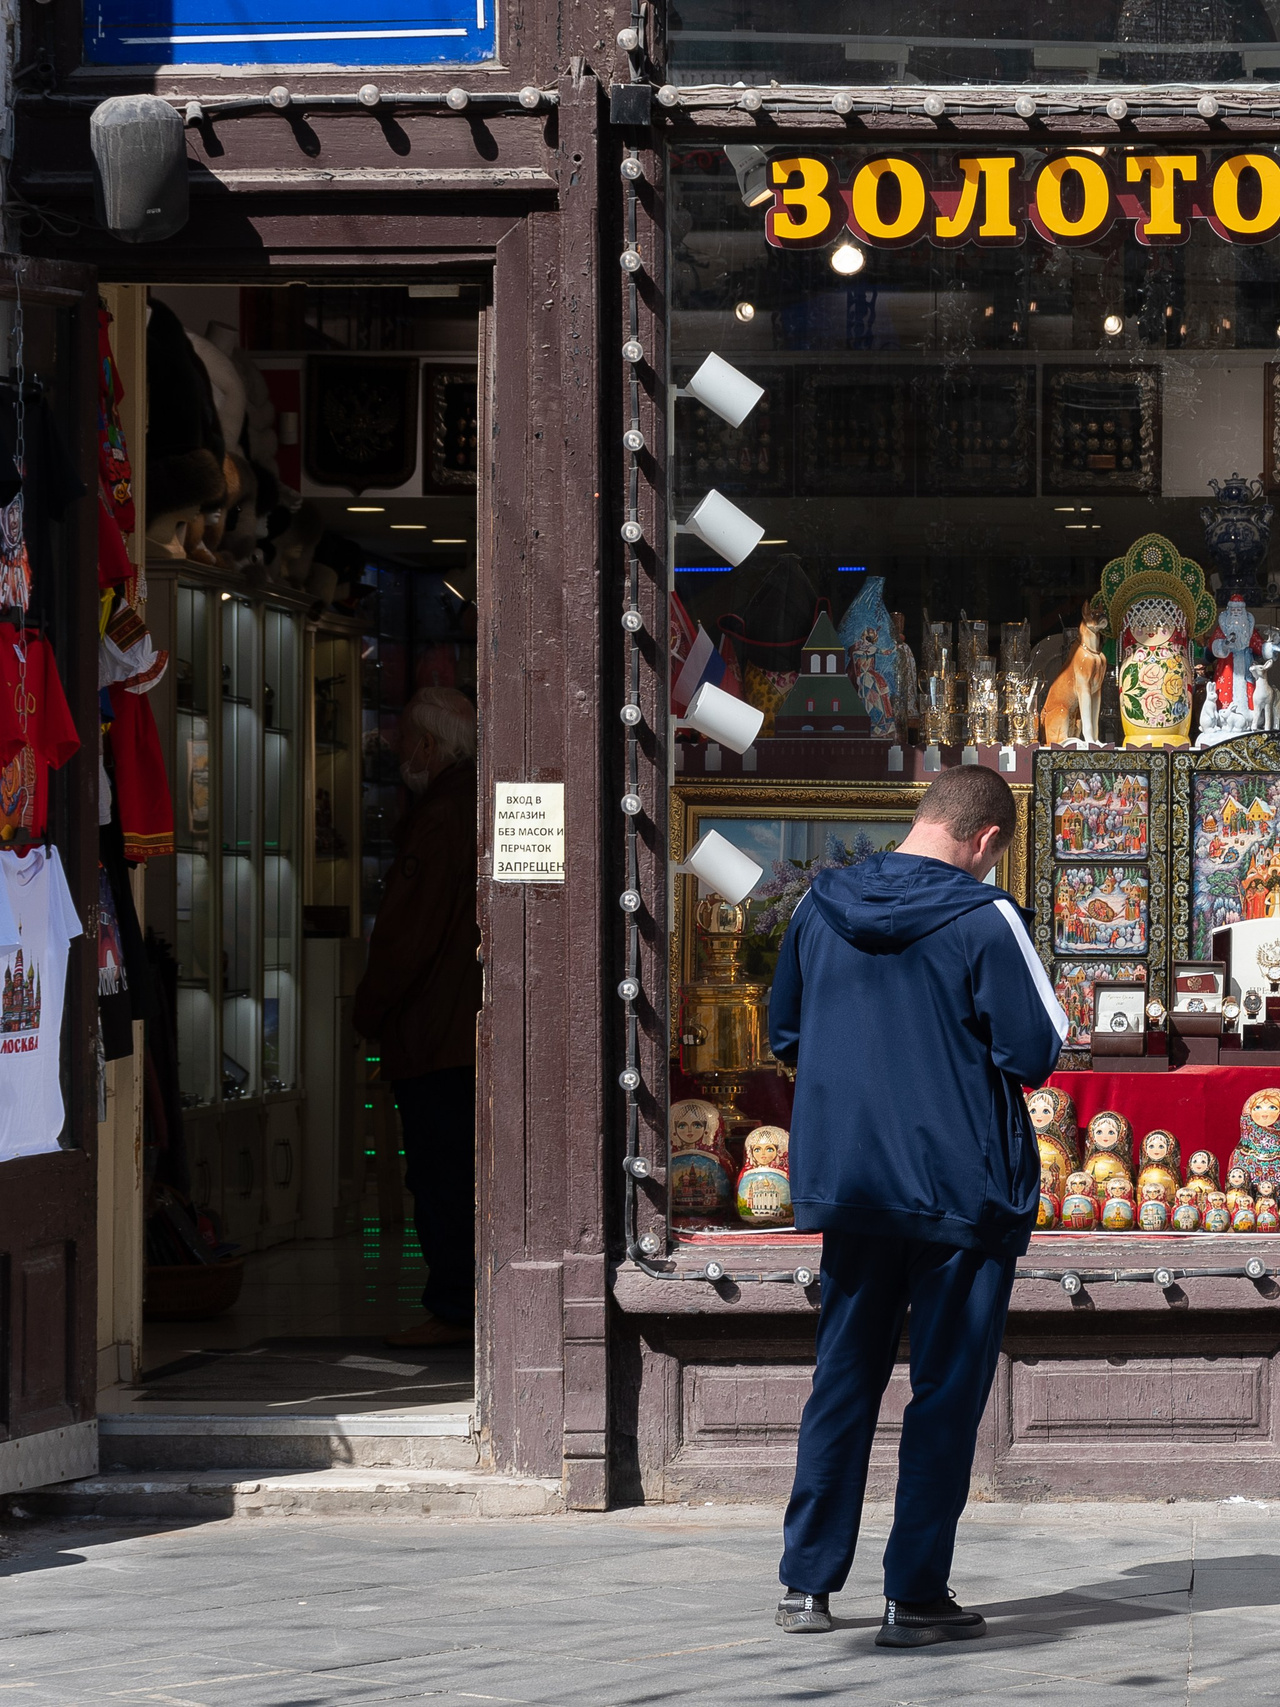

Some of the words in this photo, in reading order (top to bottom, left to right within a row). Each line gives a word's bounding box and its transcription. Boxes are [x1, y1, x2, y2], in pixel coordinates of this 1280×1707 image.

[506, 795, 533, 806] ВХОД
[535, 795, 542, 805] В
[498, 811, 546, 820] МАГАЗИН
[498, 827, 516, 836] БЕЗ
[518, 827, 554, 836] МАСОК
[556, 827, 564, 836] И
[500, 844, 552, 853] ПЕРЧАТОК
[497, 861, 565, 874] ЗАПРЕЩЕН
